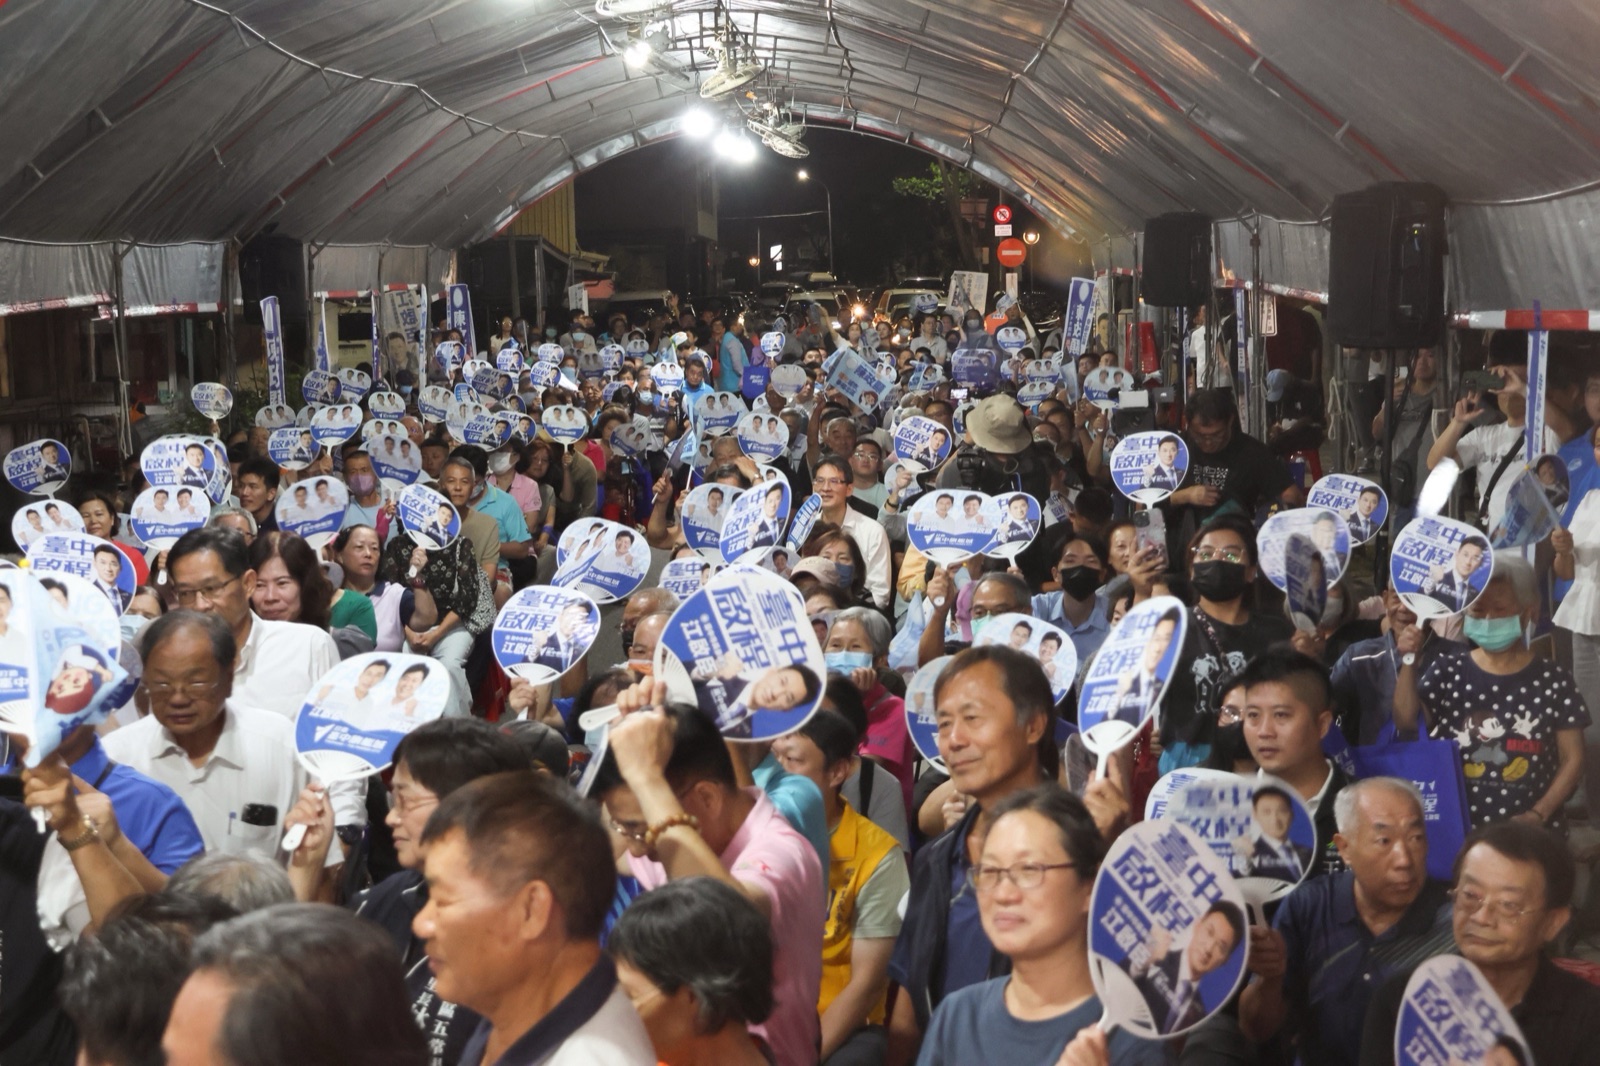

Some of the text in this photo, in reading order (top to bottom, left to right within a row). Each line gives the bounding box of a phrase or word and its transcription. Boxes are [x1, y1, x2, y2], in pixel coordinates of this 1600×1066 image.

[1122, 436, 1161, 450] 臺中
[1113, 453, 1157, 470] 啟程
[1323, 476, 1364, 495] 臺中
[1310, 490, 1357, 511] 啟程
[43, 535, 95, 557] 臺中
[1415, 519, 1468, 546] 臺中
[1397, 537, 1455, 566] 啟程
[669, 562, 703, 577] 臺中
[517, 589, 567, 609] 臺中
[498, 610, 558, 633] 啟程
[711, 584, 770, 672] 啟程
[756, 586, 810, 667] 臺中
[1116, 608, 1162, 641] 臺中
[680, 618, 718, 677] 江啟臣
[1151, 823, 1224, 907] 臺中
[1111, 845, 1195, 939] 啟程
[1099, 904, 1154, 968] 江啟臣
[1446, 963, 1507, 1035] 臺中
[1411, 978, 1486, 1064] 啟程
